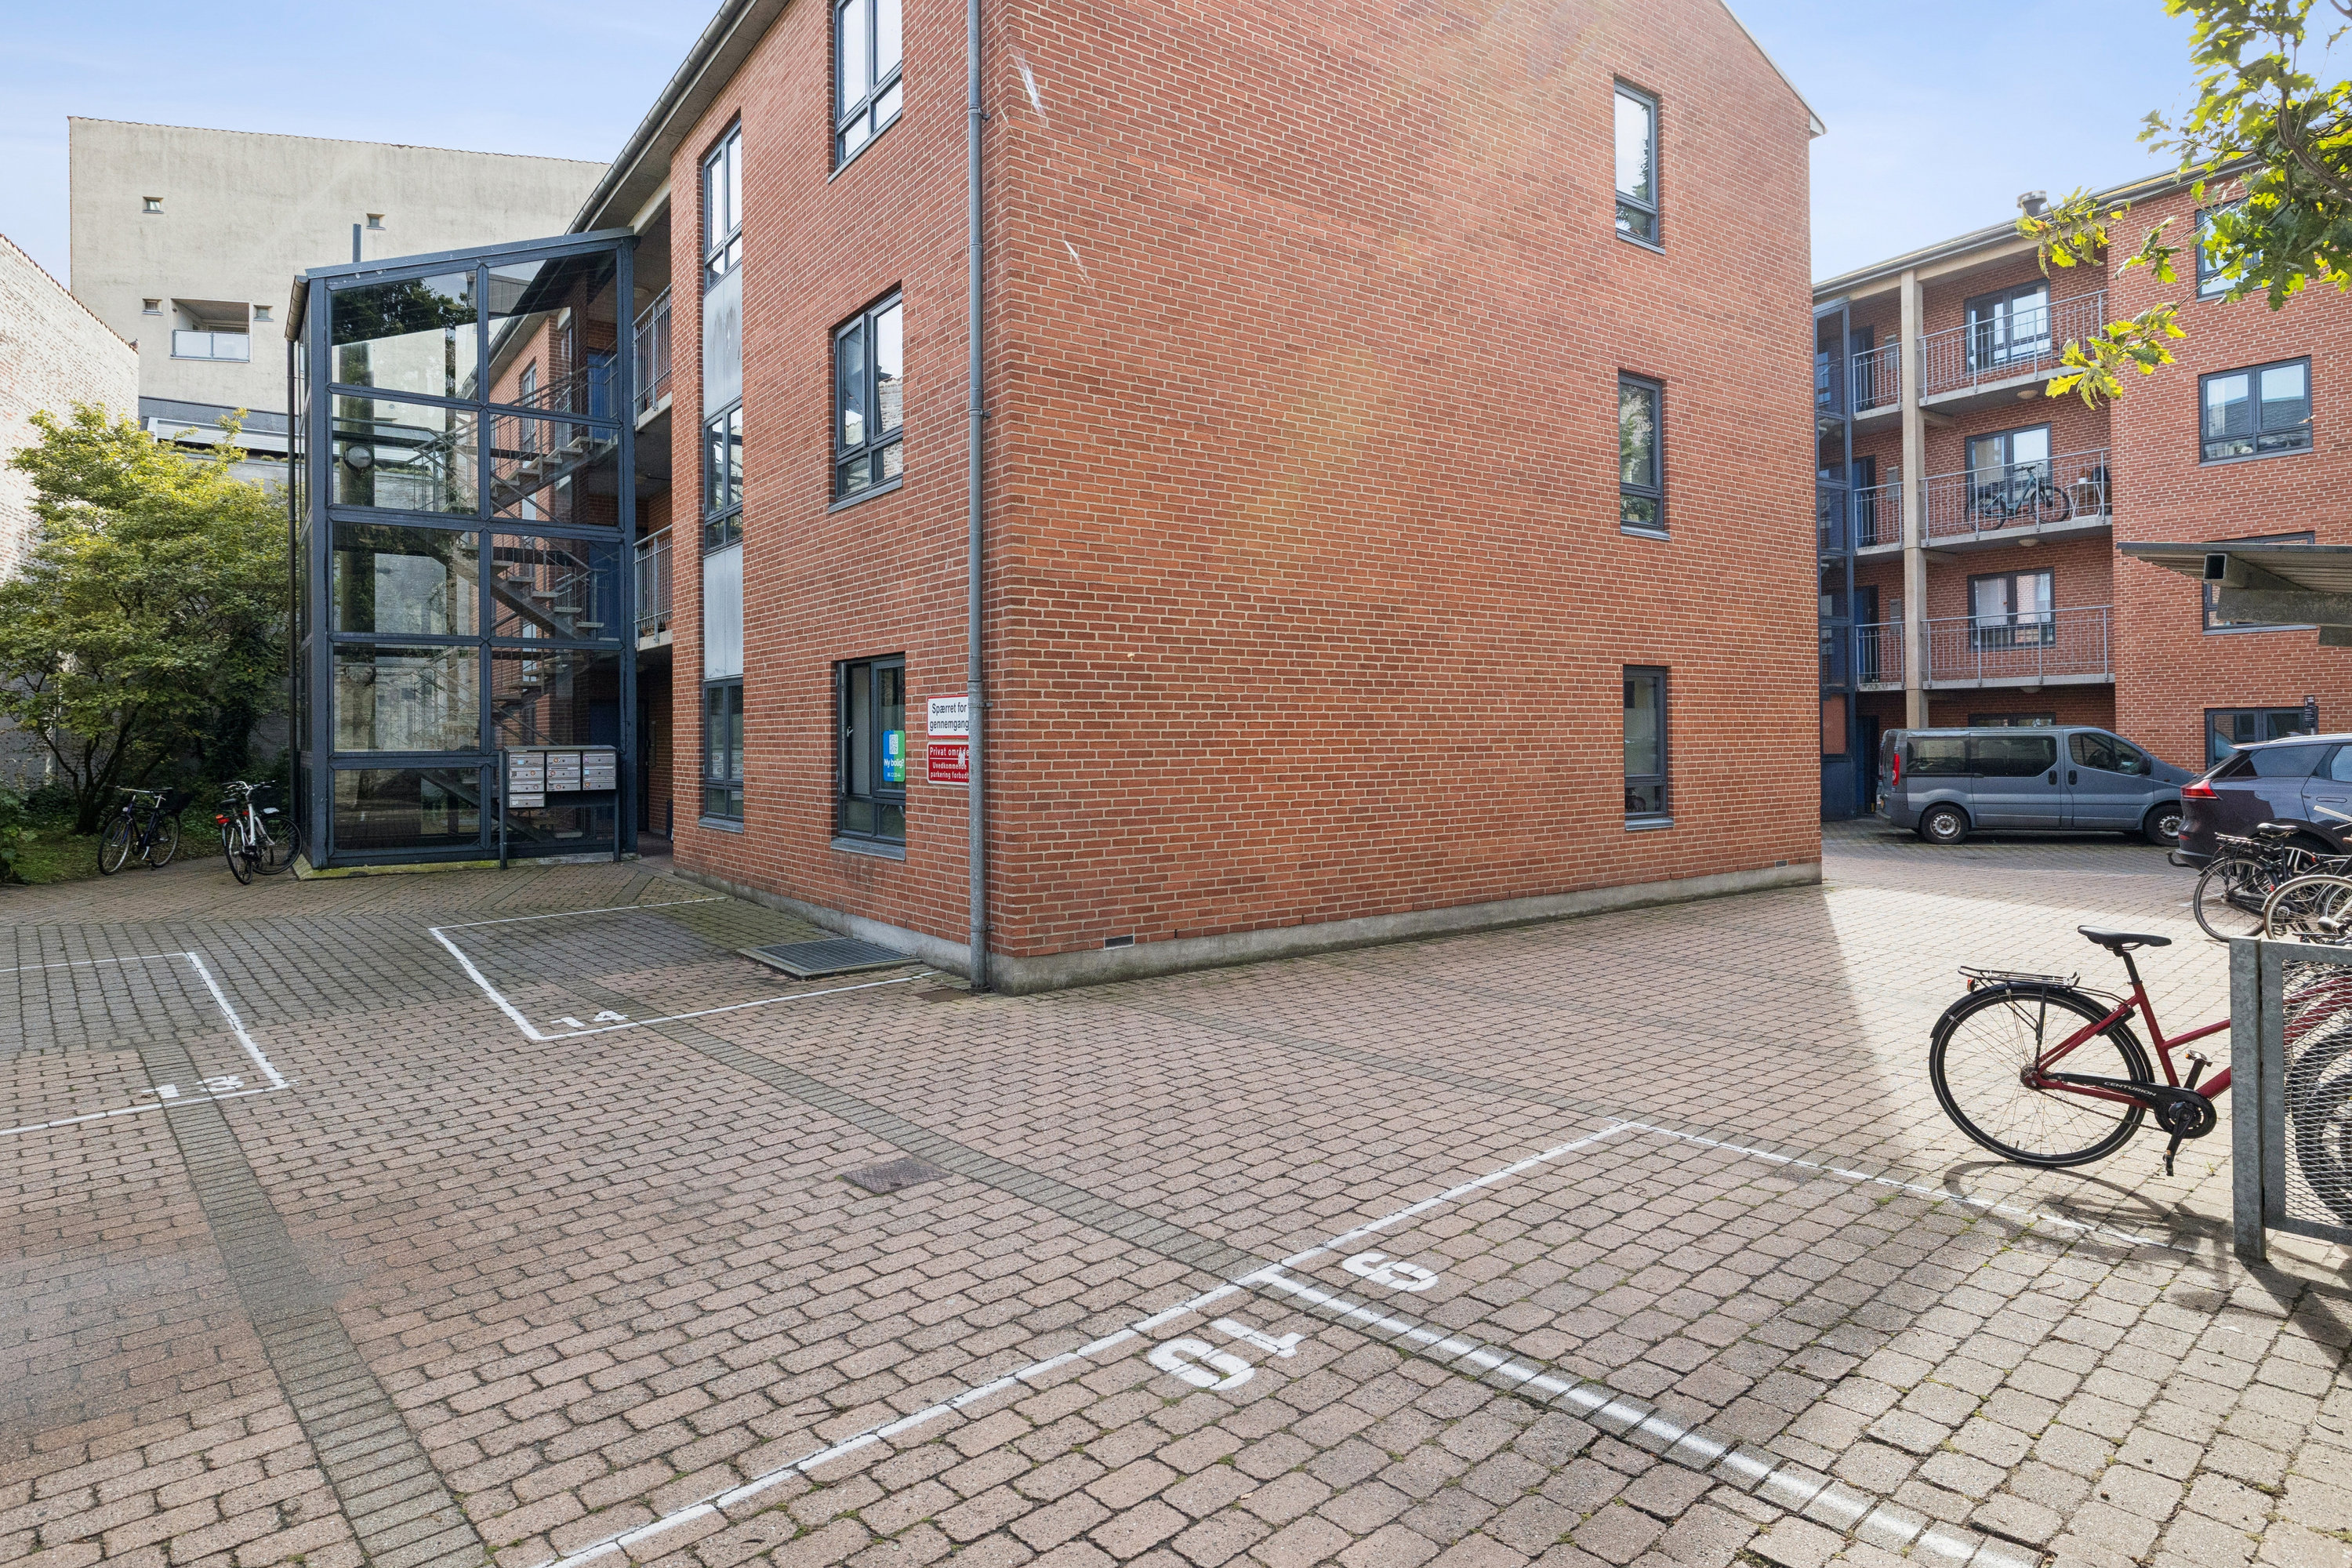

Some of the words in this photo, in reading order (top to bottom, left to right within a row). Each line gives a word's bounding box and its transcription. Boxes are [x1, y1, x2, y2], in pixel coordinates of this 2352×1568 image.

[931, 702, 956, 716] Spærret
[957, 702, 967, 713] for
[930, 720, 969, 731] gennemgang
[930, 746, 946, 756] Privat
[884, 758, 891, 768] Ny
[930, 771, 951, 780] parkering
[550, 1011, 629, 1027] 14
[140, 1076, 245, 1098] 13
[2103, 1081, 2157, 1097] CENTURION
[1147, 1317, 1306, 1391] 10
